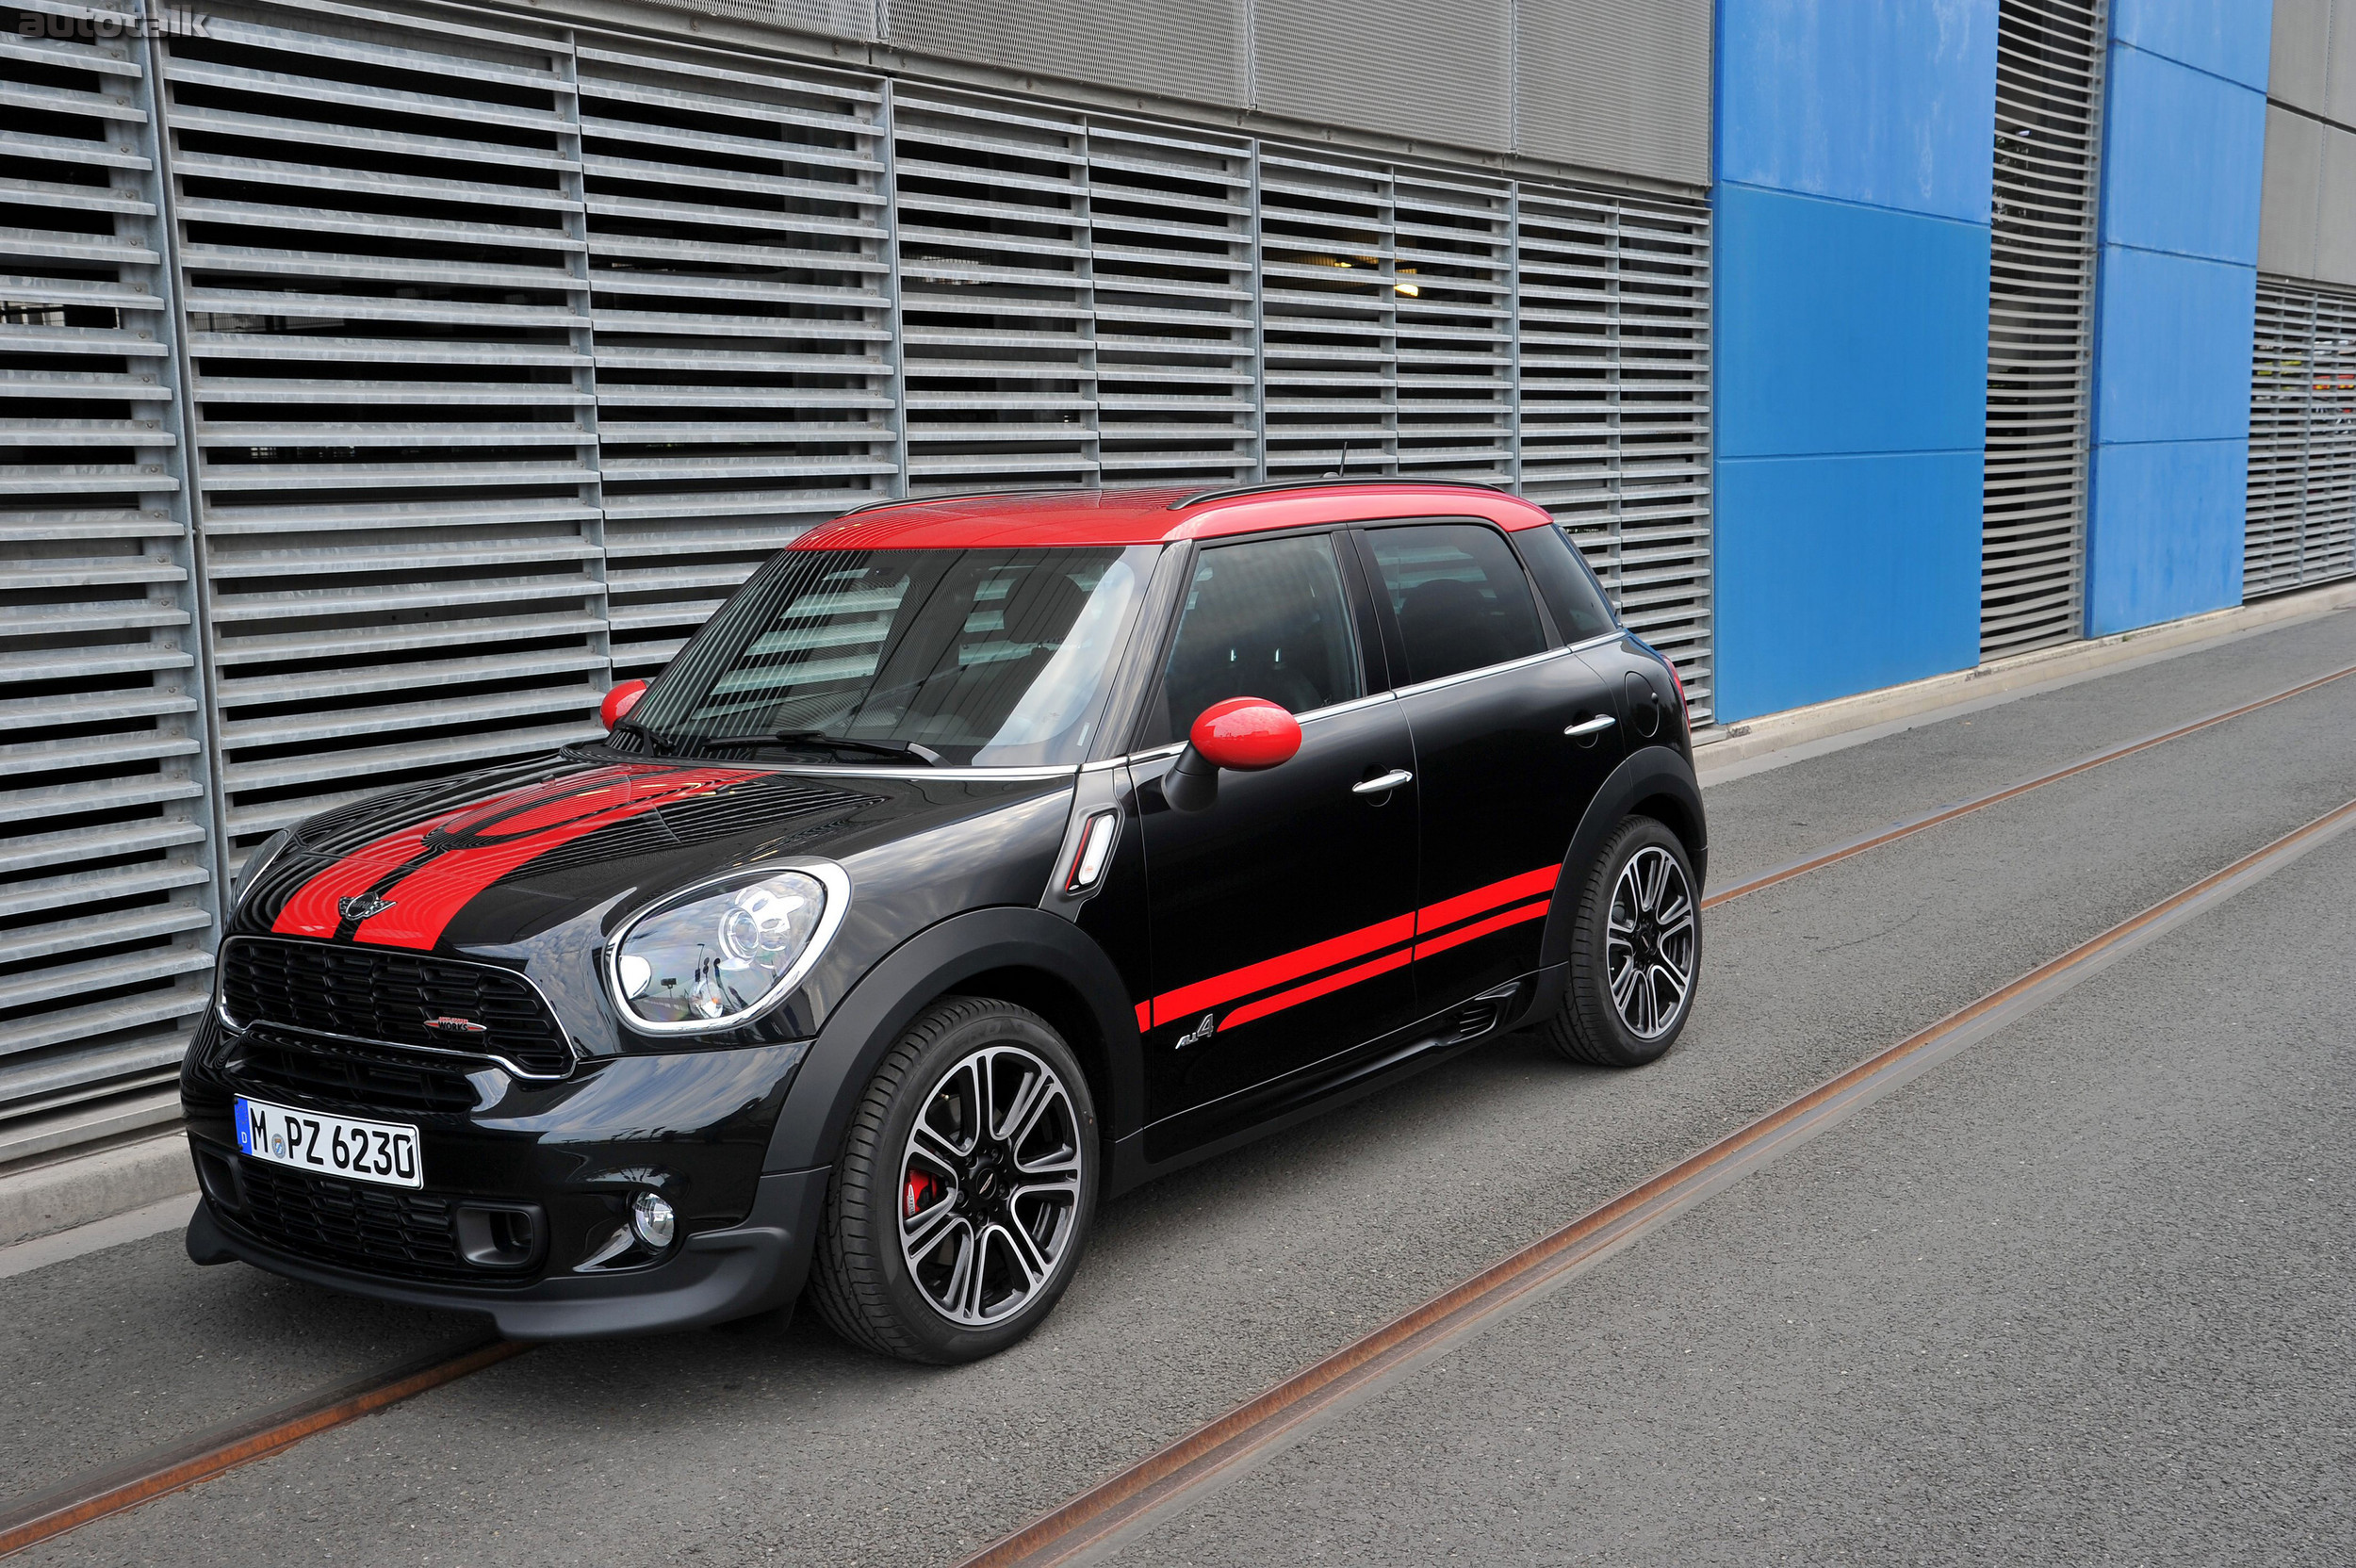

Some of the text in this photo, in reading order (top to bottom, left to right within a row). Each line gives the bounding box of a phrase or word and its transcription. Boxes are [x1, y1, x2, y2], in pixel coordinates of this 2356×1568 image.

[438, 1021, 468, 1032] WORKS
[241, 1131, 248, 1144] D
[250, 1107, 416, 1179] M PZ 6230
